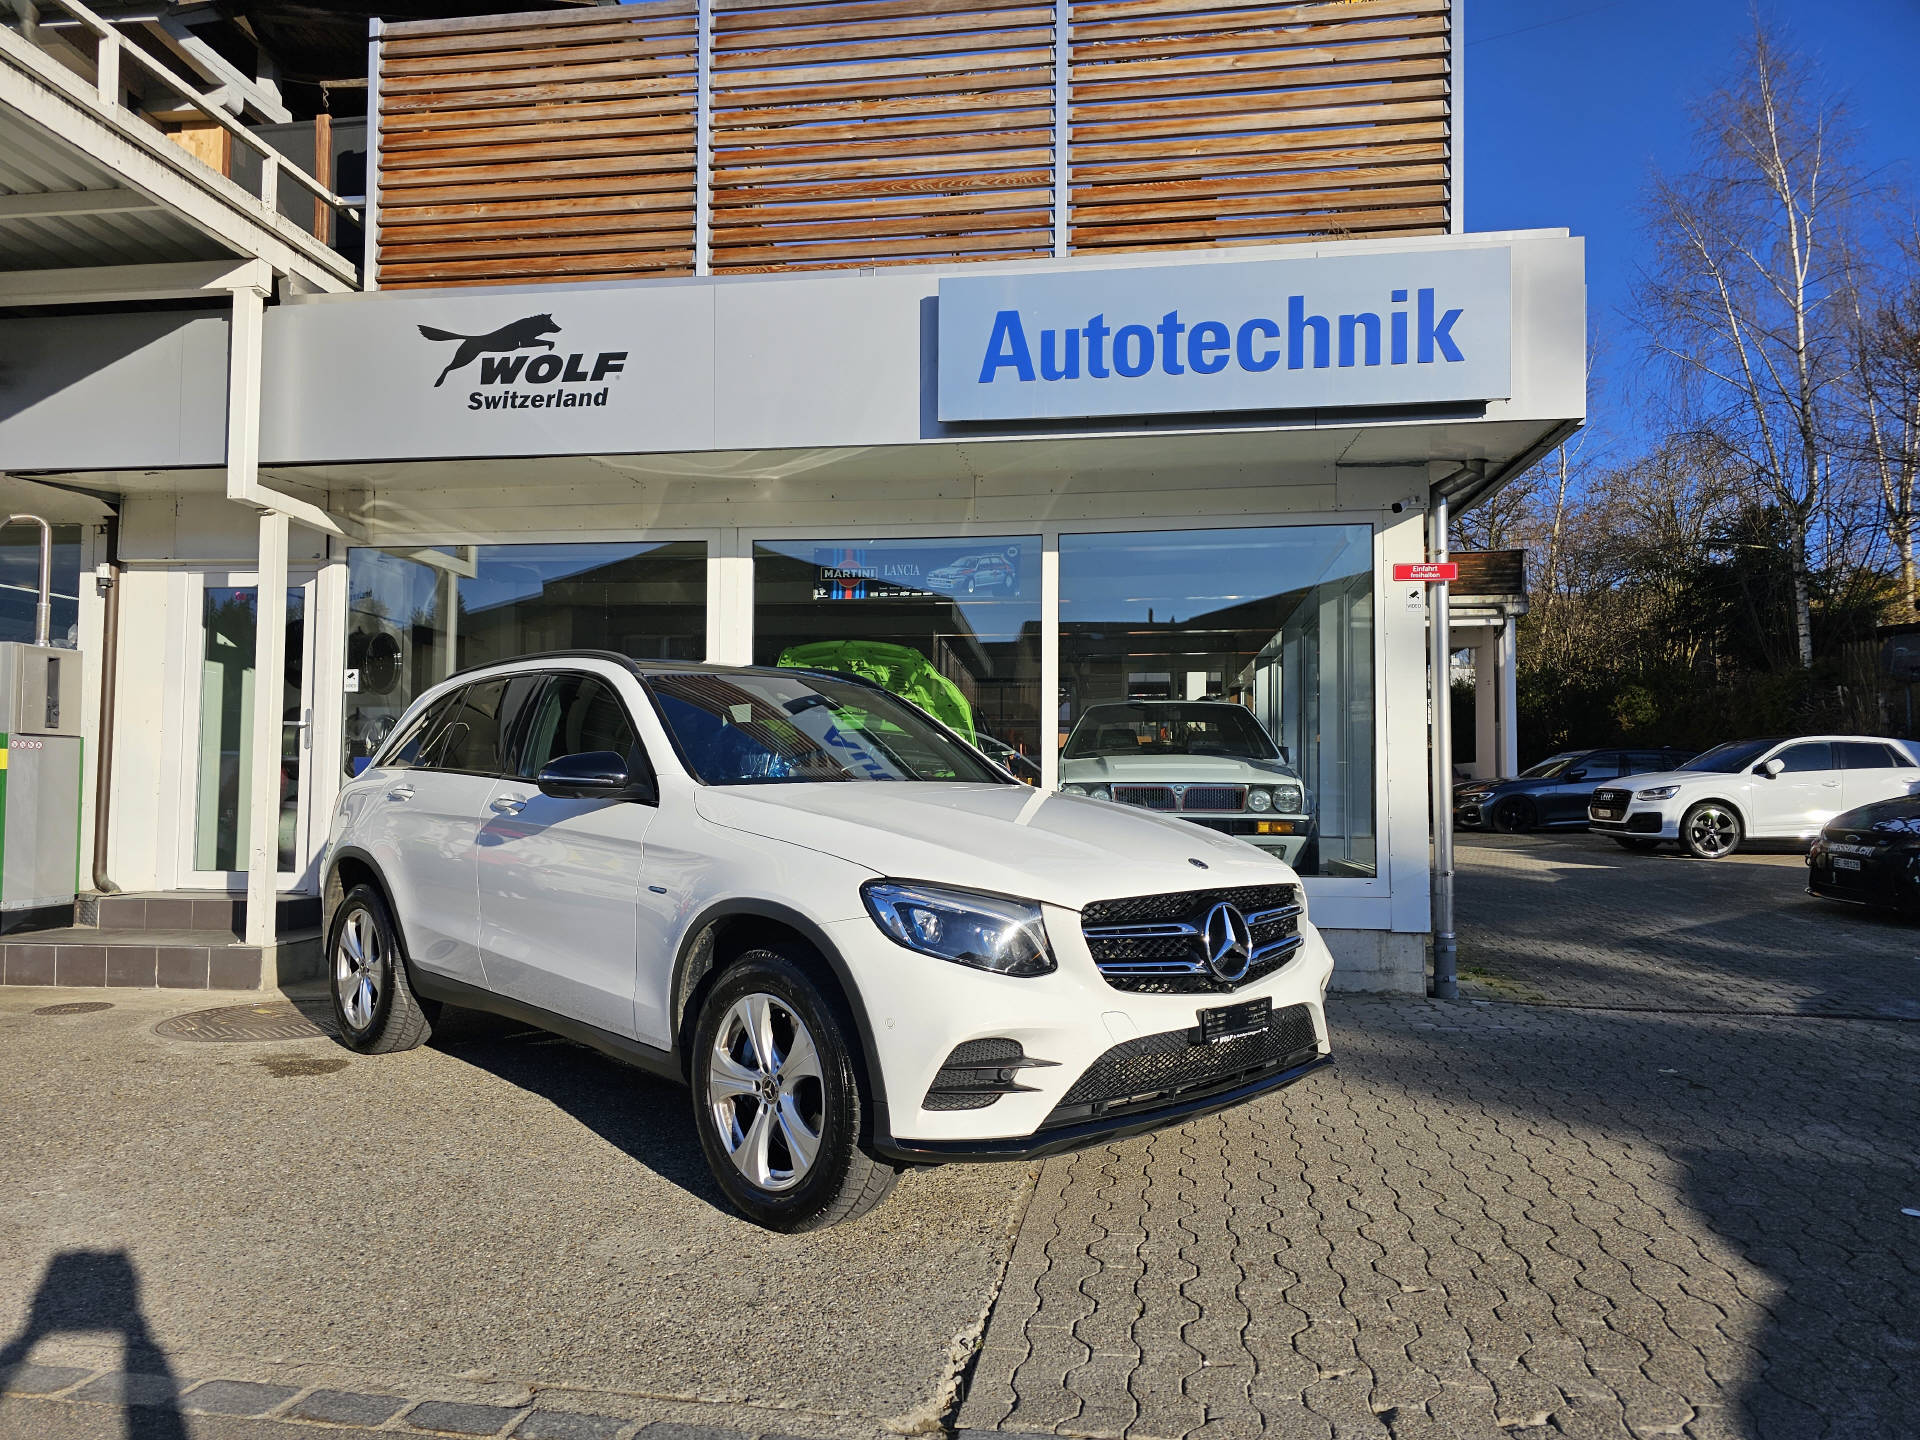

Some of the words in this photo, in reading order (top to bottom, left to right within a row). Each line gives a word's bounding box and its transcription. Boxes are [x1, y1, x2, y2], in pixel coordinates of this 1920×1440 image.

[977, 287, 1465, 384] Autotechnik
[480, 351, 628, 385] WOLF
[467, 387, 609, 411] Switzerland
[824, 569, 875, 578] MARTINI
[884, 564, 920, 576] LANCIA
